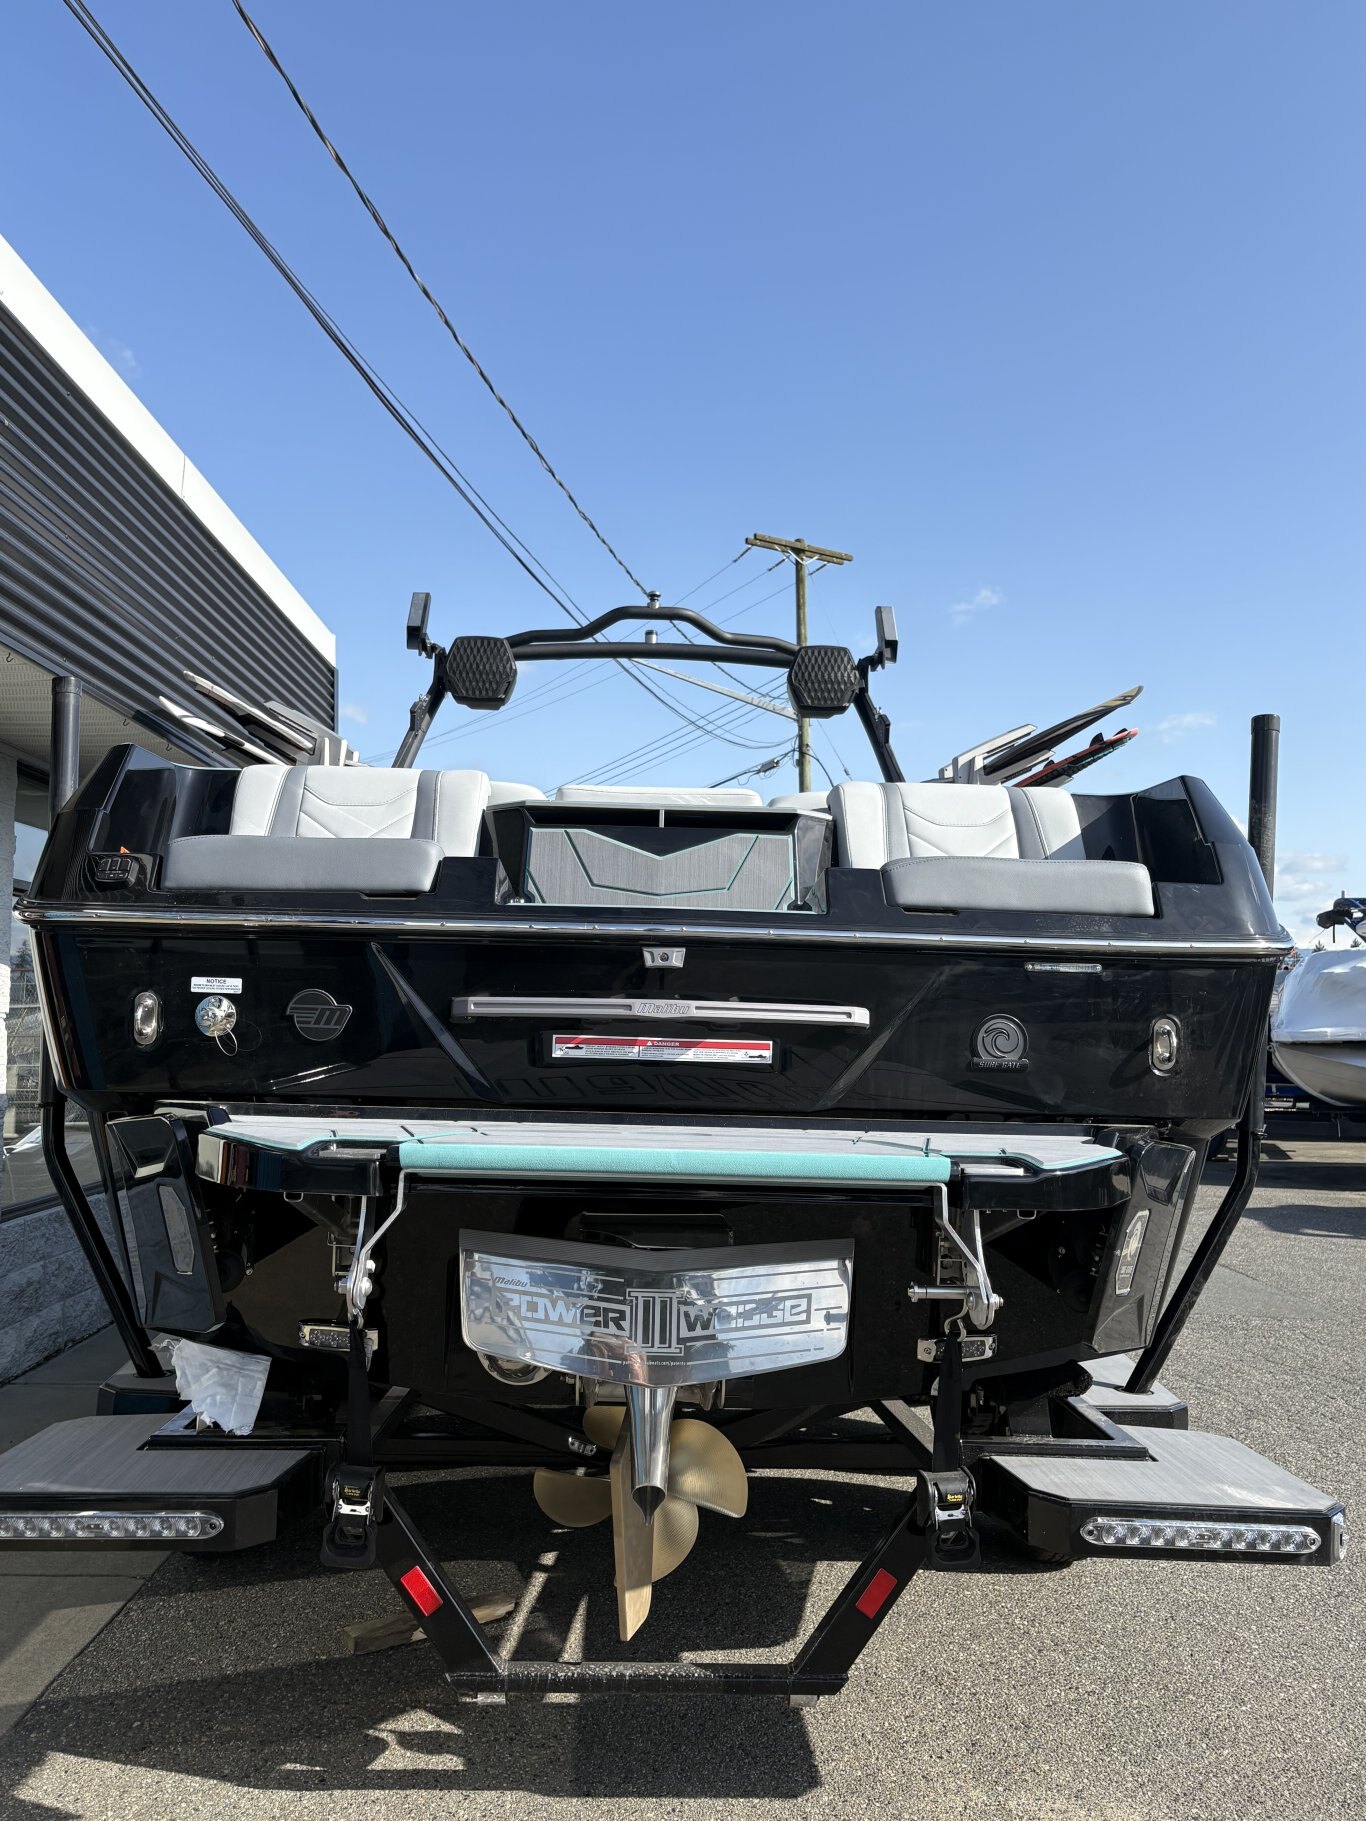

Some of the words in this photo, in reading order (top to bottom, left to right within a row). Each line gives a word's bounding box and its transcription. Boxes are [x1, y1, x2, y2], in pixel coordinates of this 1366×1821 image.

[637, 1002, 690, 1015] Malibu
[1001, 1061, 1023, 1069] GATE
[494, 1276, 529, 1288] Malibu
